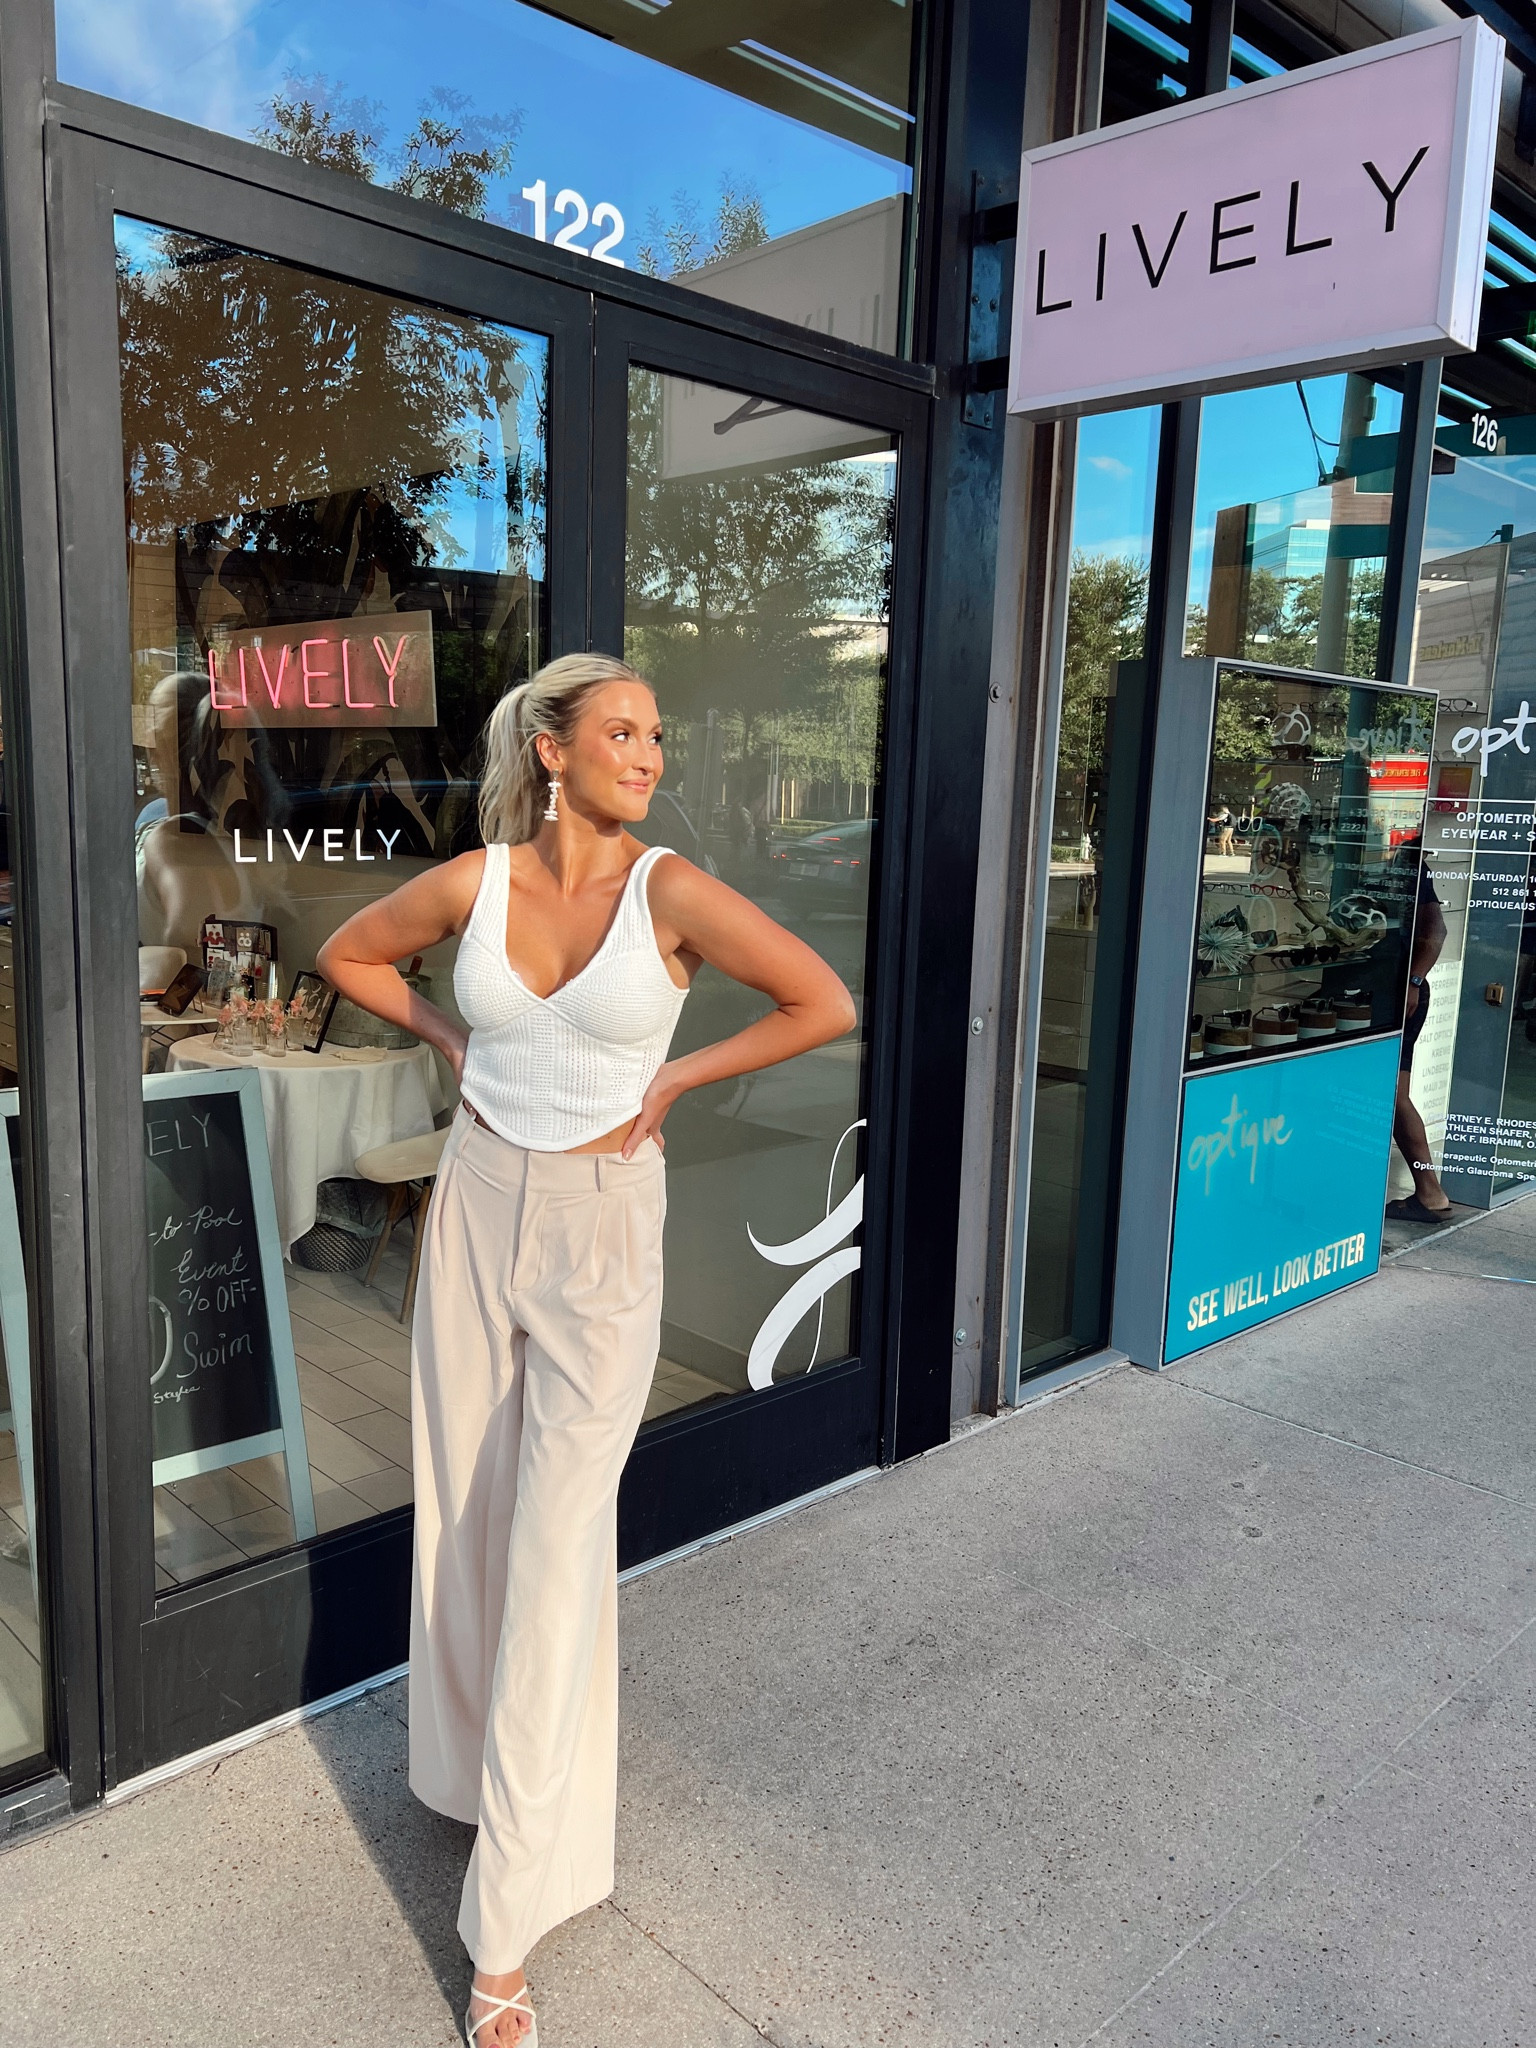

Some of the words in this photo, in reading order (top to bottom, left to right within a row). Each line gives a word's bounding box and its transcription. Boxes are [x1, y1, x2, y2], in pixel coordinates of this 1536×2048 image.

[522, 179, 625, 268] 122
[1035, 146, 1430, 316] LIVELY
[1471, 412, 1498, 452] 126
[208, 635, 409, 709] LIVELY
[1441, 828, 1507, 840] EYEWEAR
[1512, 832, 1522, 840] +
[1456, 812, 1536, 825] OPTOMETRY
[233, 828, 401, 862] LIVELY
[1492, 888, 1509, 896] 512
[1512, 888, 1529, 897] 861
[1484, 1117, 1494, 1125] E.
[1489, 1128, 1532, 1139] SHAFER,
[1187, 1093, 1294, 1197] optique
[1433, 1150, 1488, 1163] Therapeutic
[1469, 1135, 1477, 1143] F.
[1479, 1136, 1524, 1148] IBRAHIM,
[1413, 1161, 1465, 1174] Optometric
[1467, 1166, 1513, 1179] Glaucoma
[170, 1245, 249, 1284] Event
[1187, 1287, 1220, 1332] SEE
[1223, 1272, 1269, 1318] WELL,
[1272, 1252, 1312, 1297] LOOK
[1313, 1232, 1366, 1281] BETTER
[176, 1331, 253, 1379] Swim
